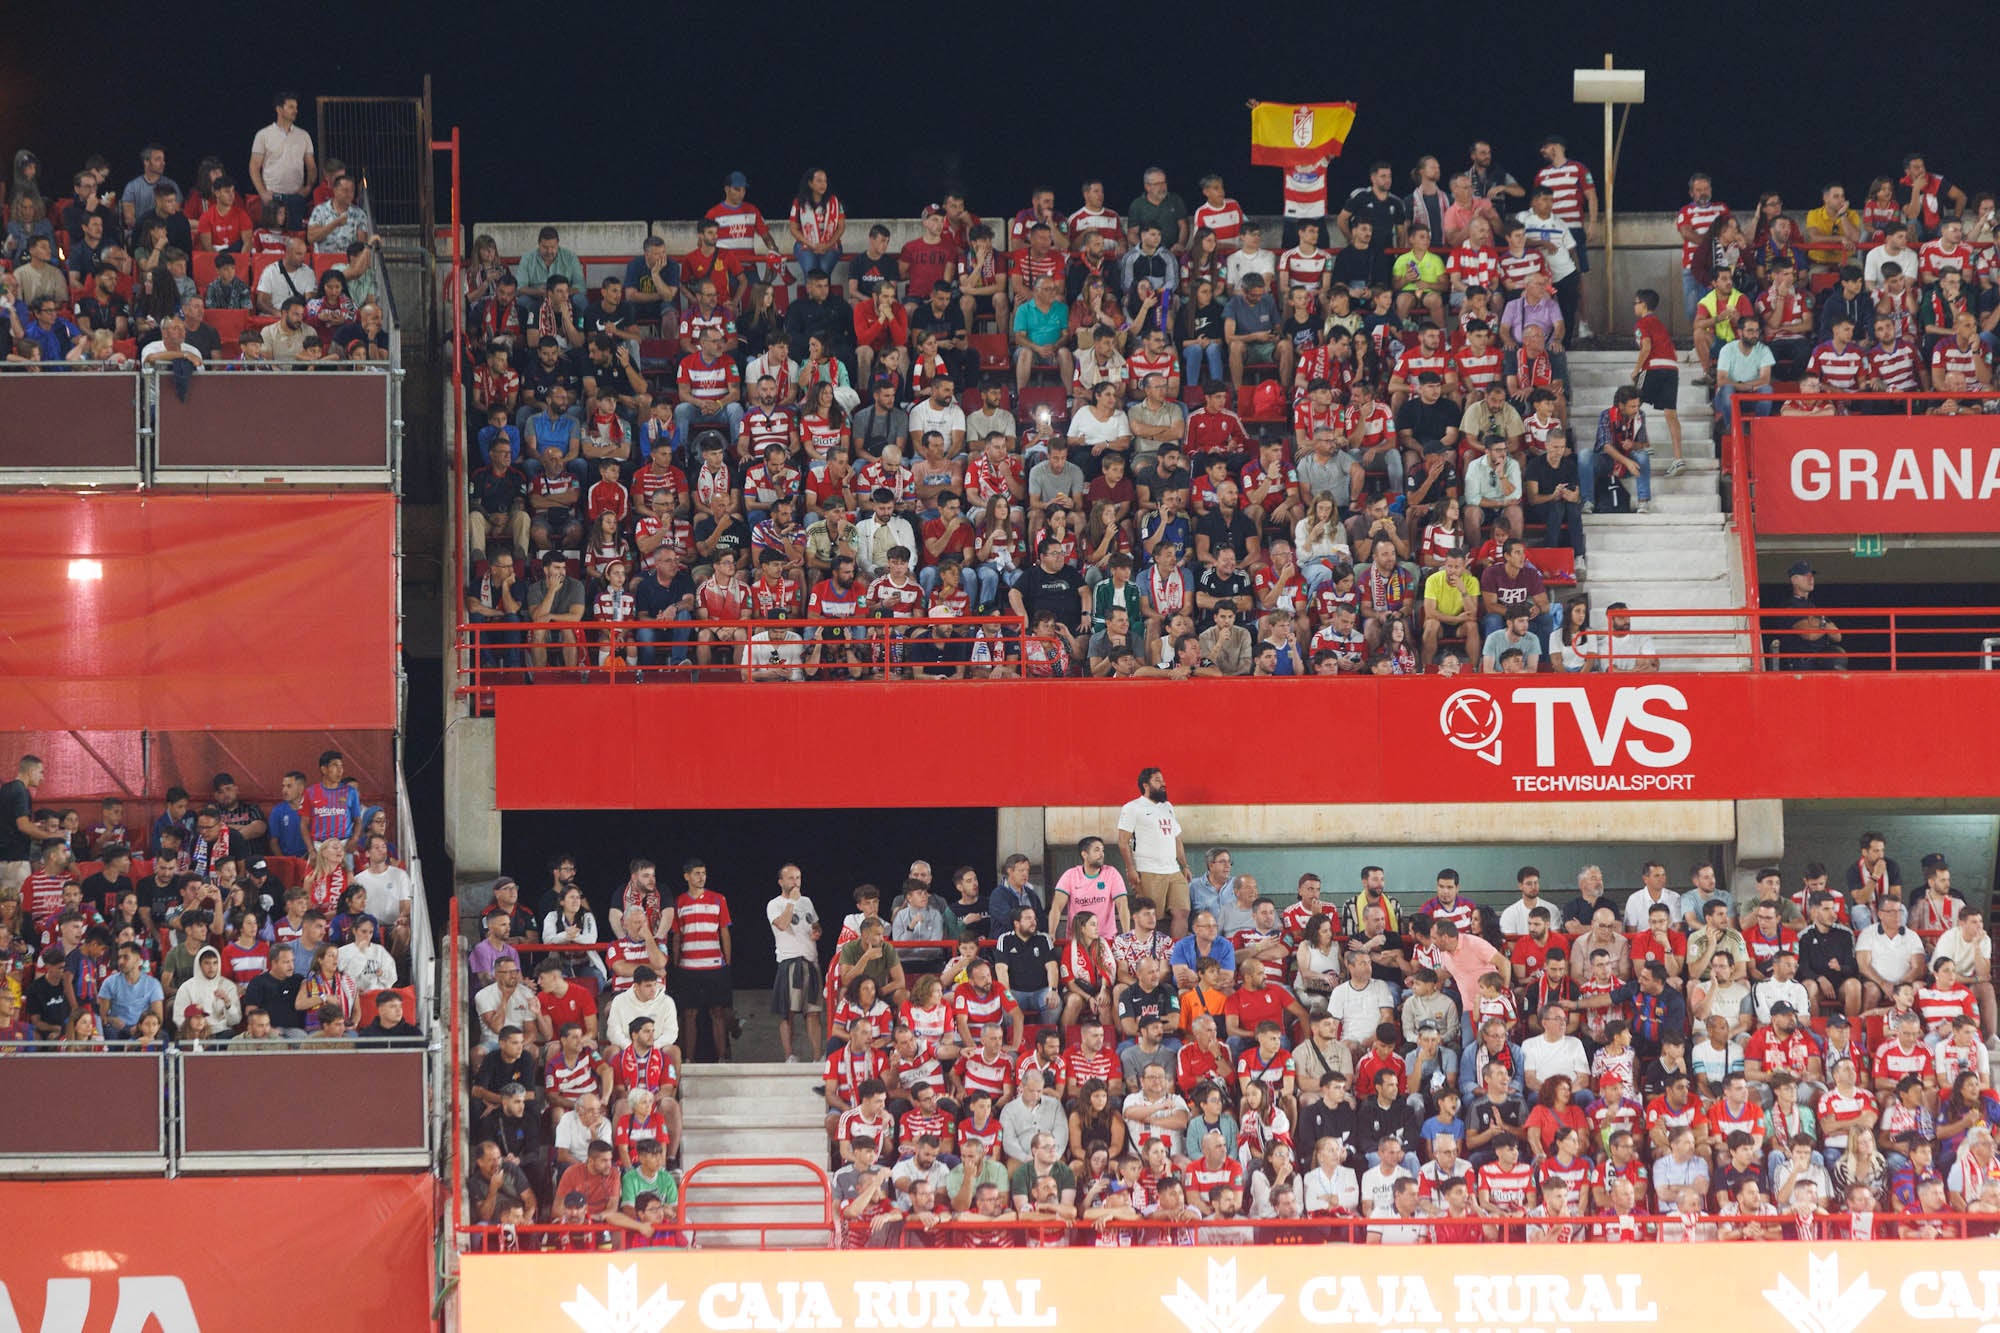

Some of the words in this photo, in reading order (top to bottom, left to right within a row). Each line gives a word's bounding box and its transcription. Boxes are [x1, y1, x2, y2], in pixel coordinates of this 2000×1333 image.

[1511, 684, 1692, 768] TVS
[1512, 774, 1695, 791] TECHVISUALSPORT
[313, 805, 345, 817] Rakuten
[1074, 895, 1106, 906] Rakuten
[698, 1281, 843, 1332] CAJA
[852, 1279, 1057, 1329] RURAL
[1298, 1275, 1443, 1327] CAJA
[1453, 1273, 1658, 1323] RURAL
